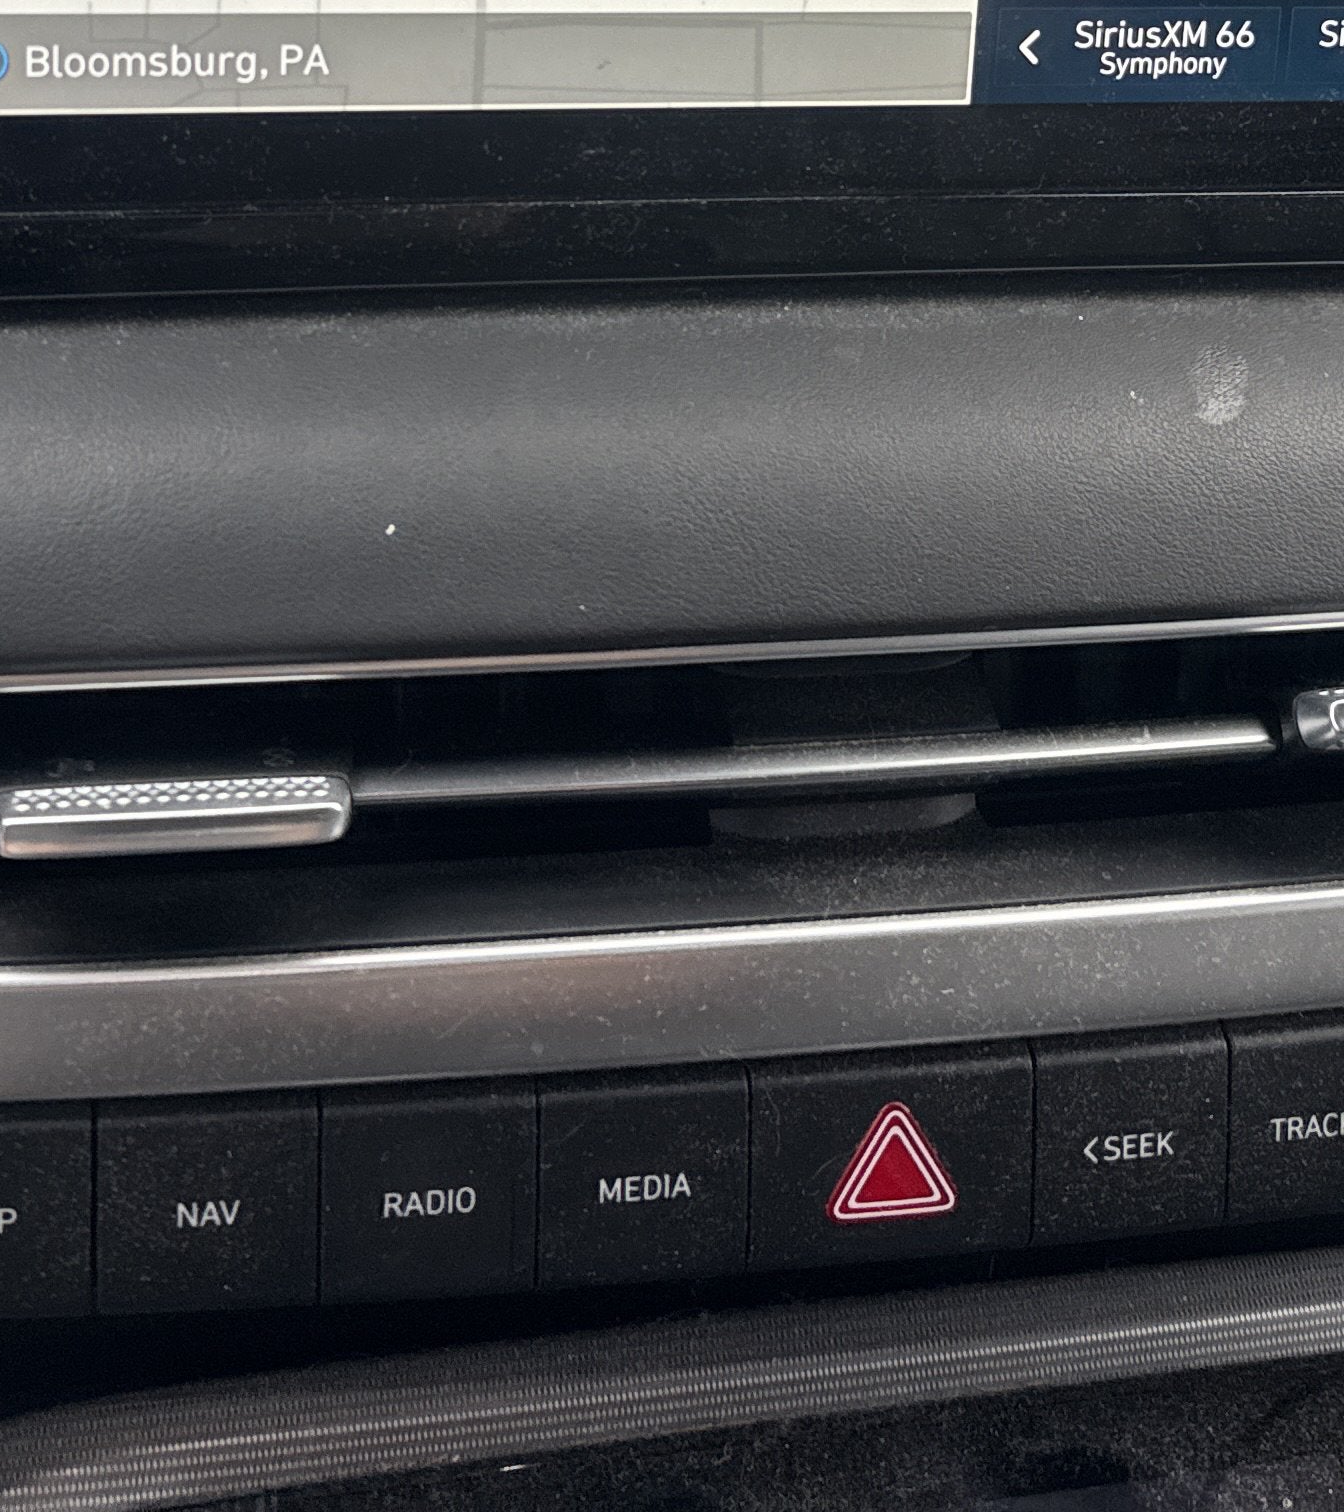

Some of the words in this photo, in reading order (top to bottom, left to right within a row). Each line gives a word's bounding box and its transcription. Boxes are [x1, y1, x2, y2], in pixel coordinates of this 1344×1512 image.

[1075, 20, 1206, 48] SiriusXM
[1216, 21, 1254, 47] 66
[26, 45, 268, 84] Bloomsburg,
[280, 44, 330, 76] PA
[1100, 52, 1227, 79] Symphony
[383, 1186, 476, 1218] RADIO
[599, 1173, 691, 1204] MEDIA
[177, 1199, 240, 1228] NAV
